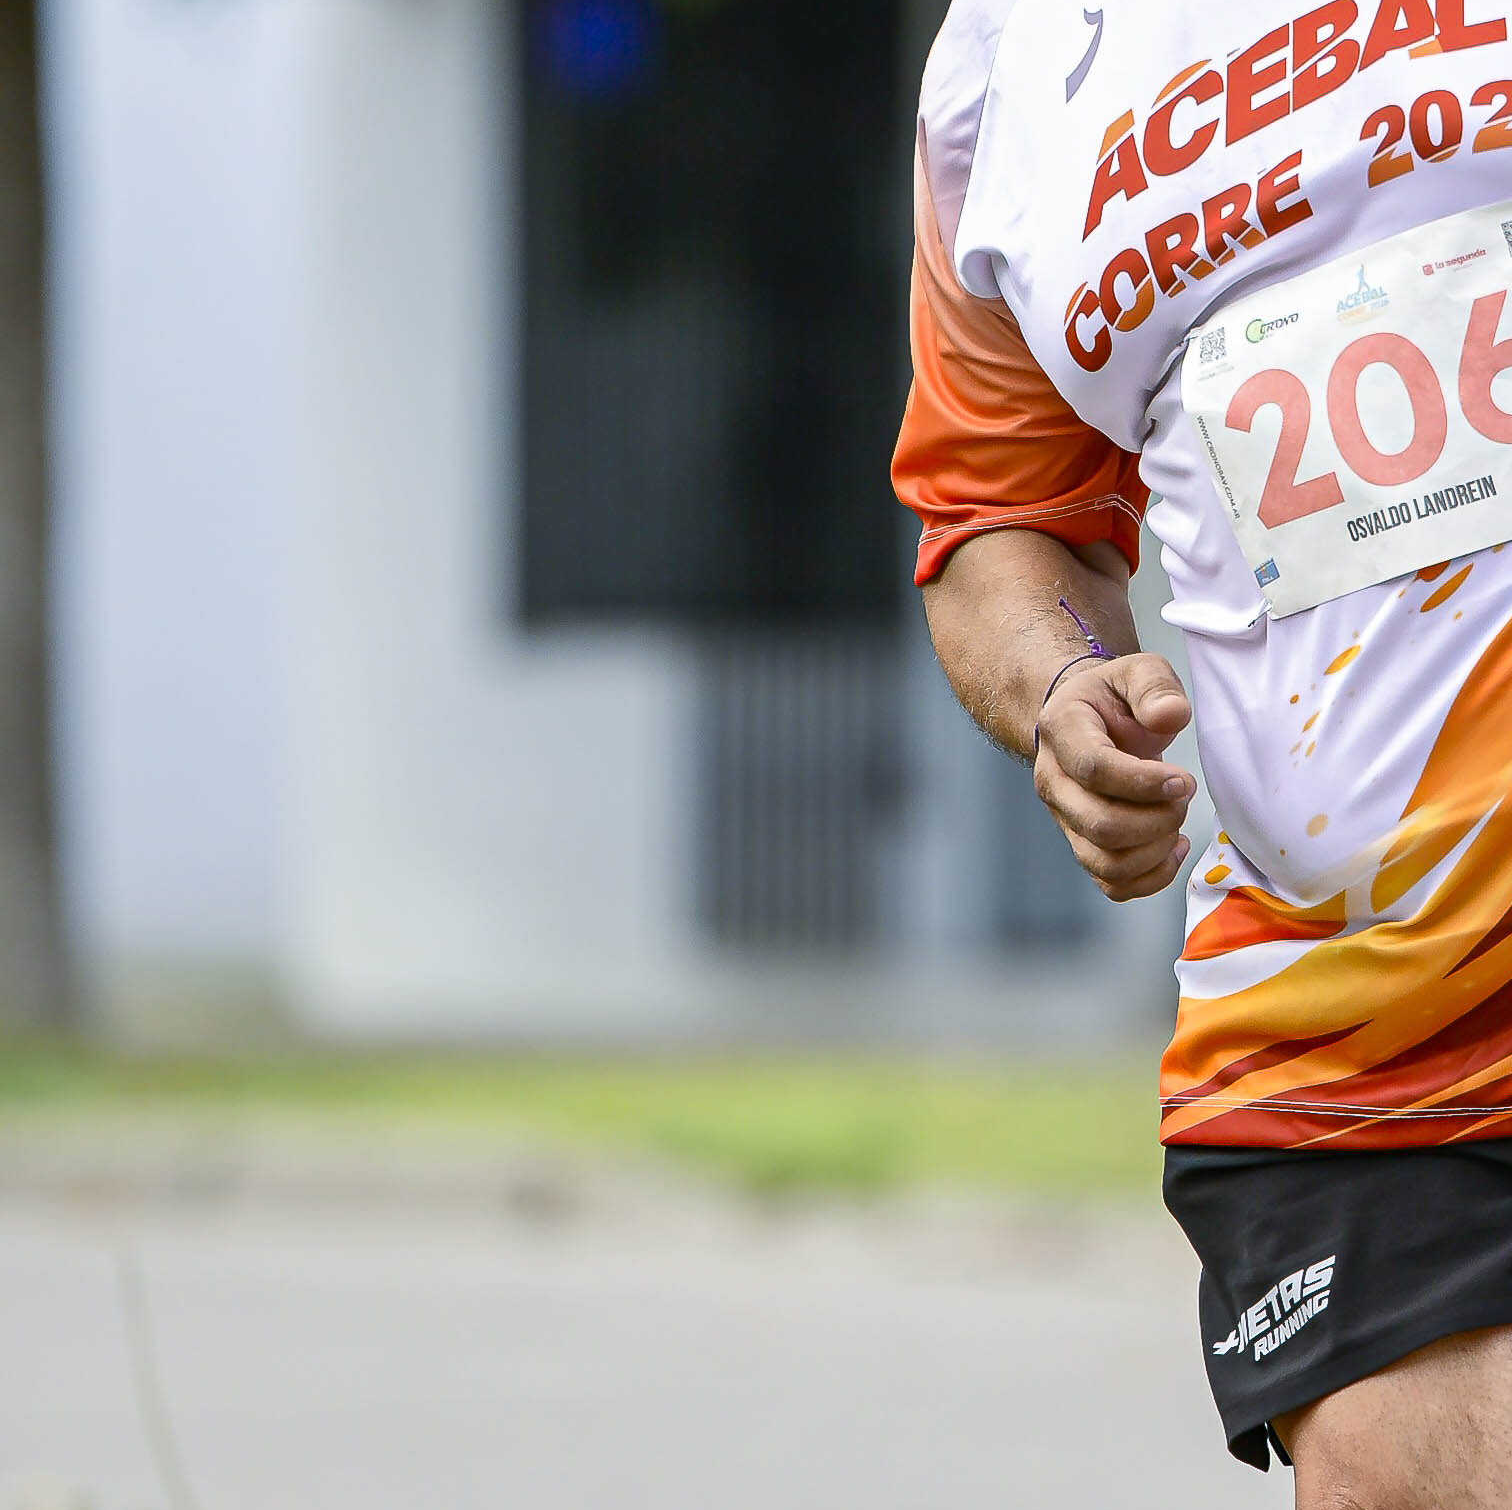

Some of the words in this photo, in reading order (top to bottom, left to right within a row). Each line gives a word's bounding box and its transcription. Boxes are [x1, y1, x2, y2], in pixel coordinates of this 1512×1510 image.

[1063, 148, 1314, 373] CORRE
[1346, 502, 1412, 542] OSVALDO
[1413, 475, 1497, 519] LANDREIN
[1254, 1289, 1331, 1362] RUNNING
